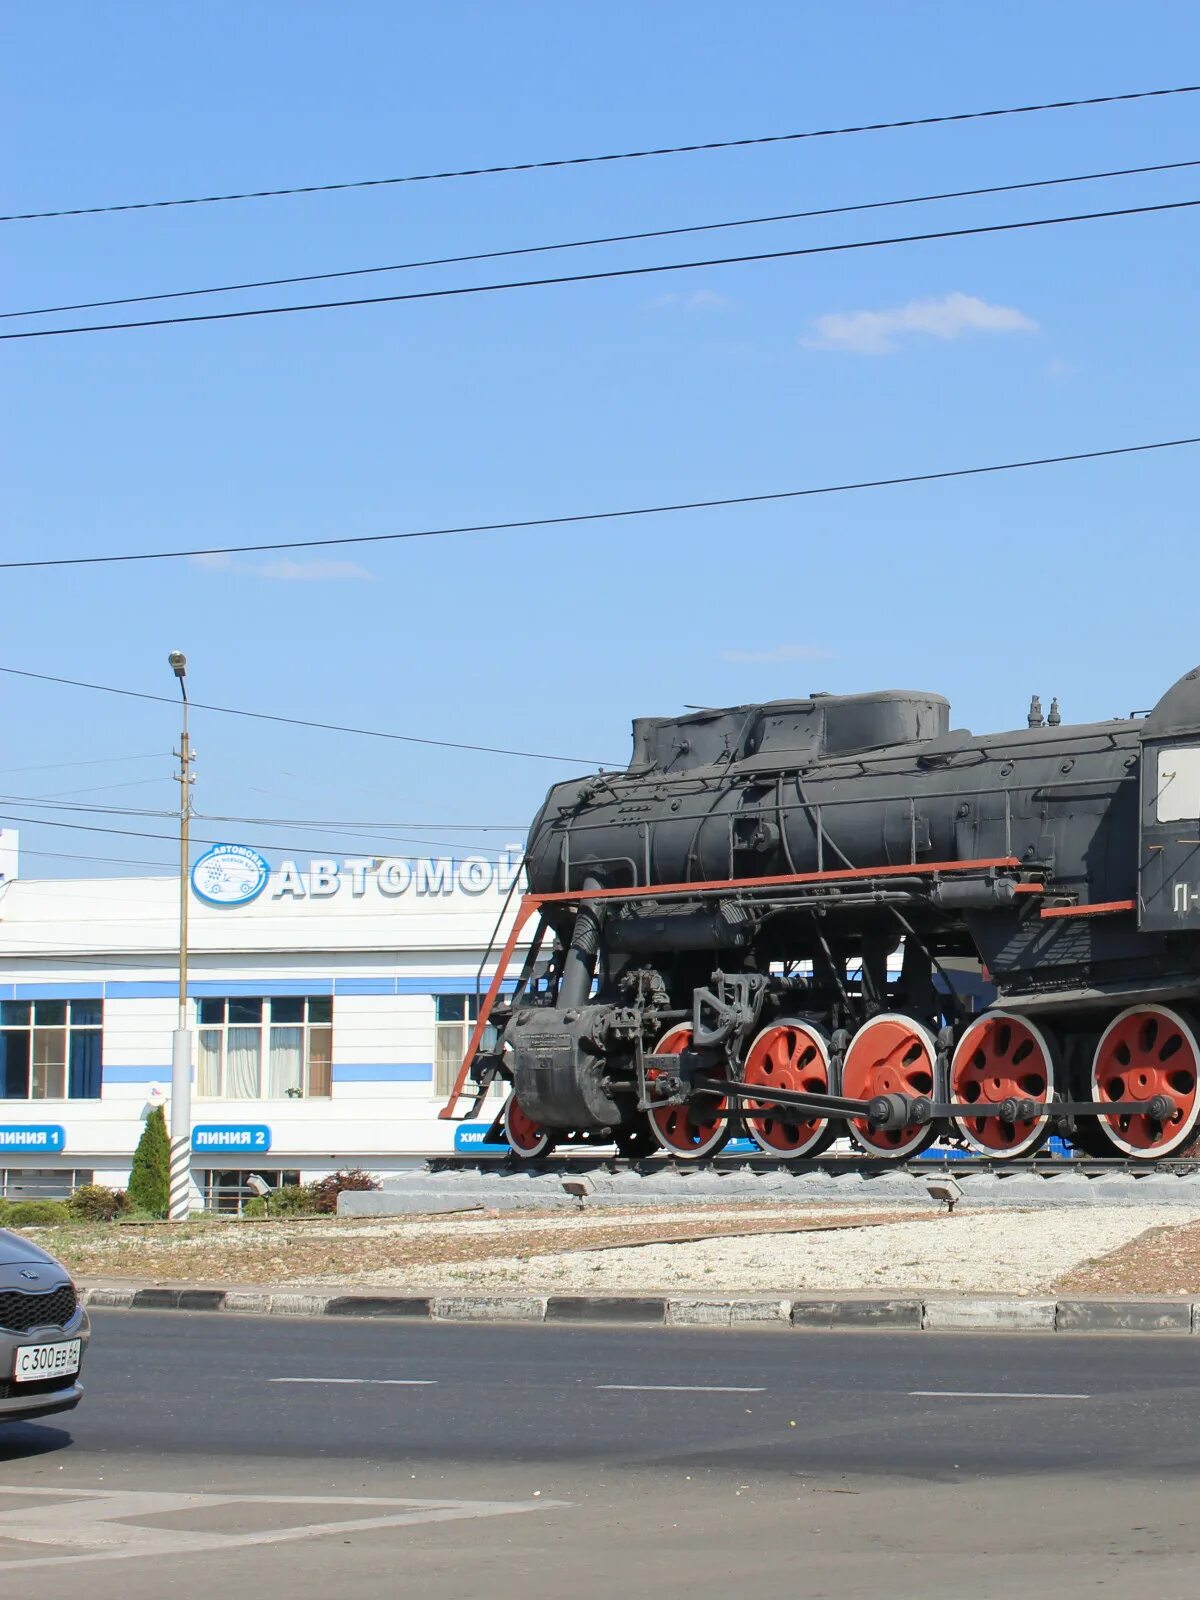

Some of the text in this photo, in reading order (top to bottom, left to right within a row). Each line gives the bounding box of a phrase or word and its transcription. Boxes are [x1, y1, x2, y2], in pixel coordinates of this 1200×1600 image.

[214, 845, 266, 875] АВТОМОЙКА
[51, 1132, 58, 1144] 1
[196, 1132, 265, 1145] ЛИНИЯ 2
